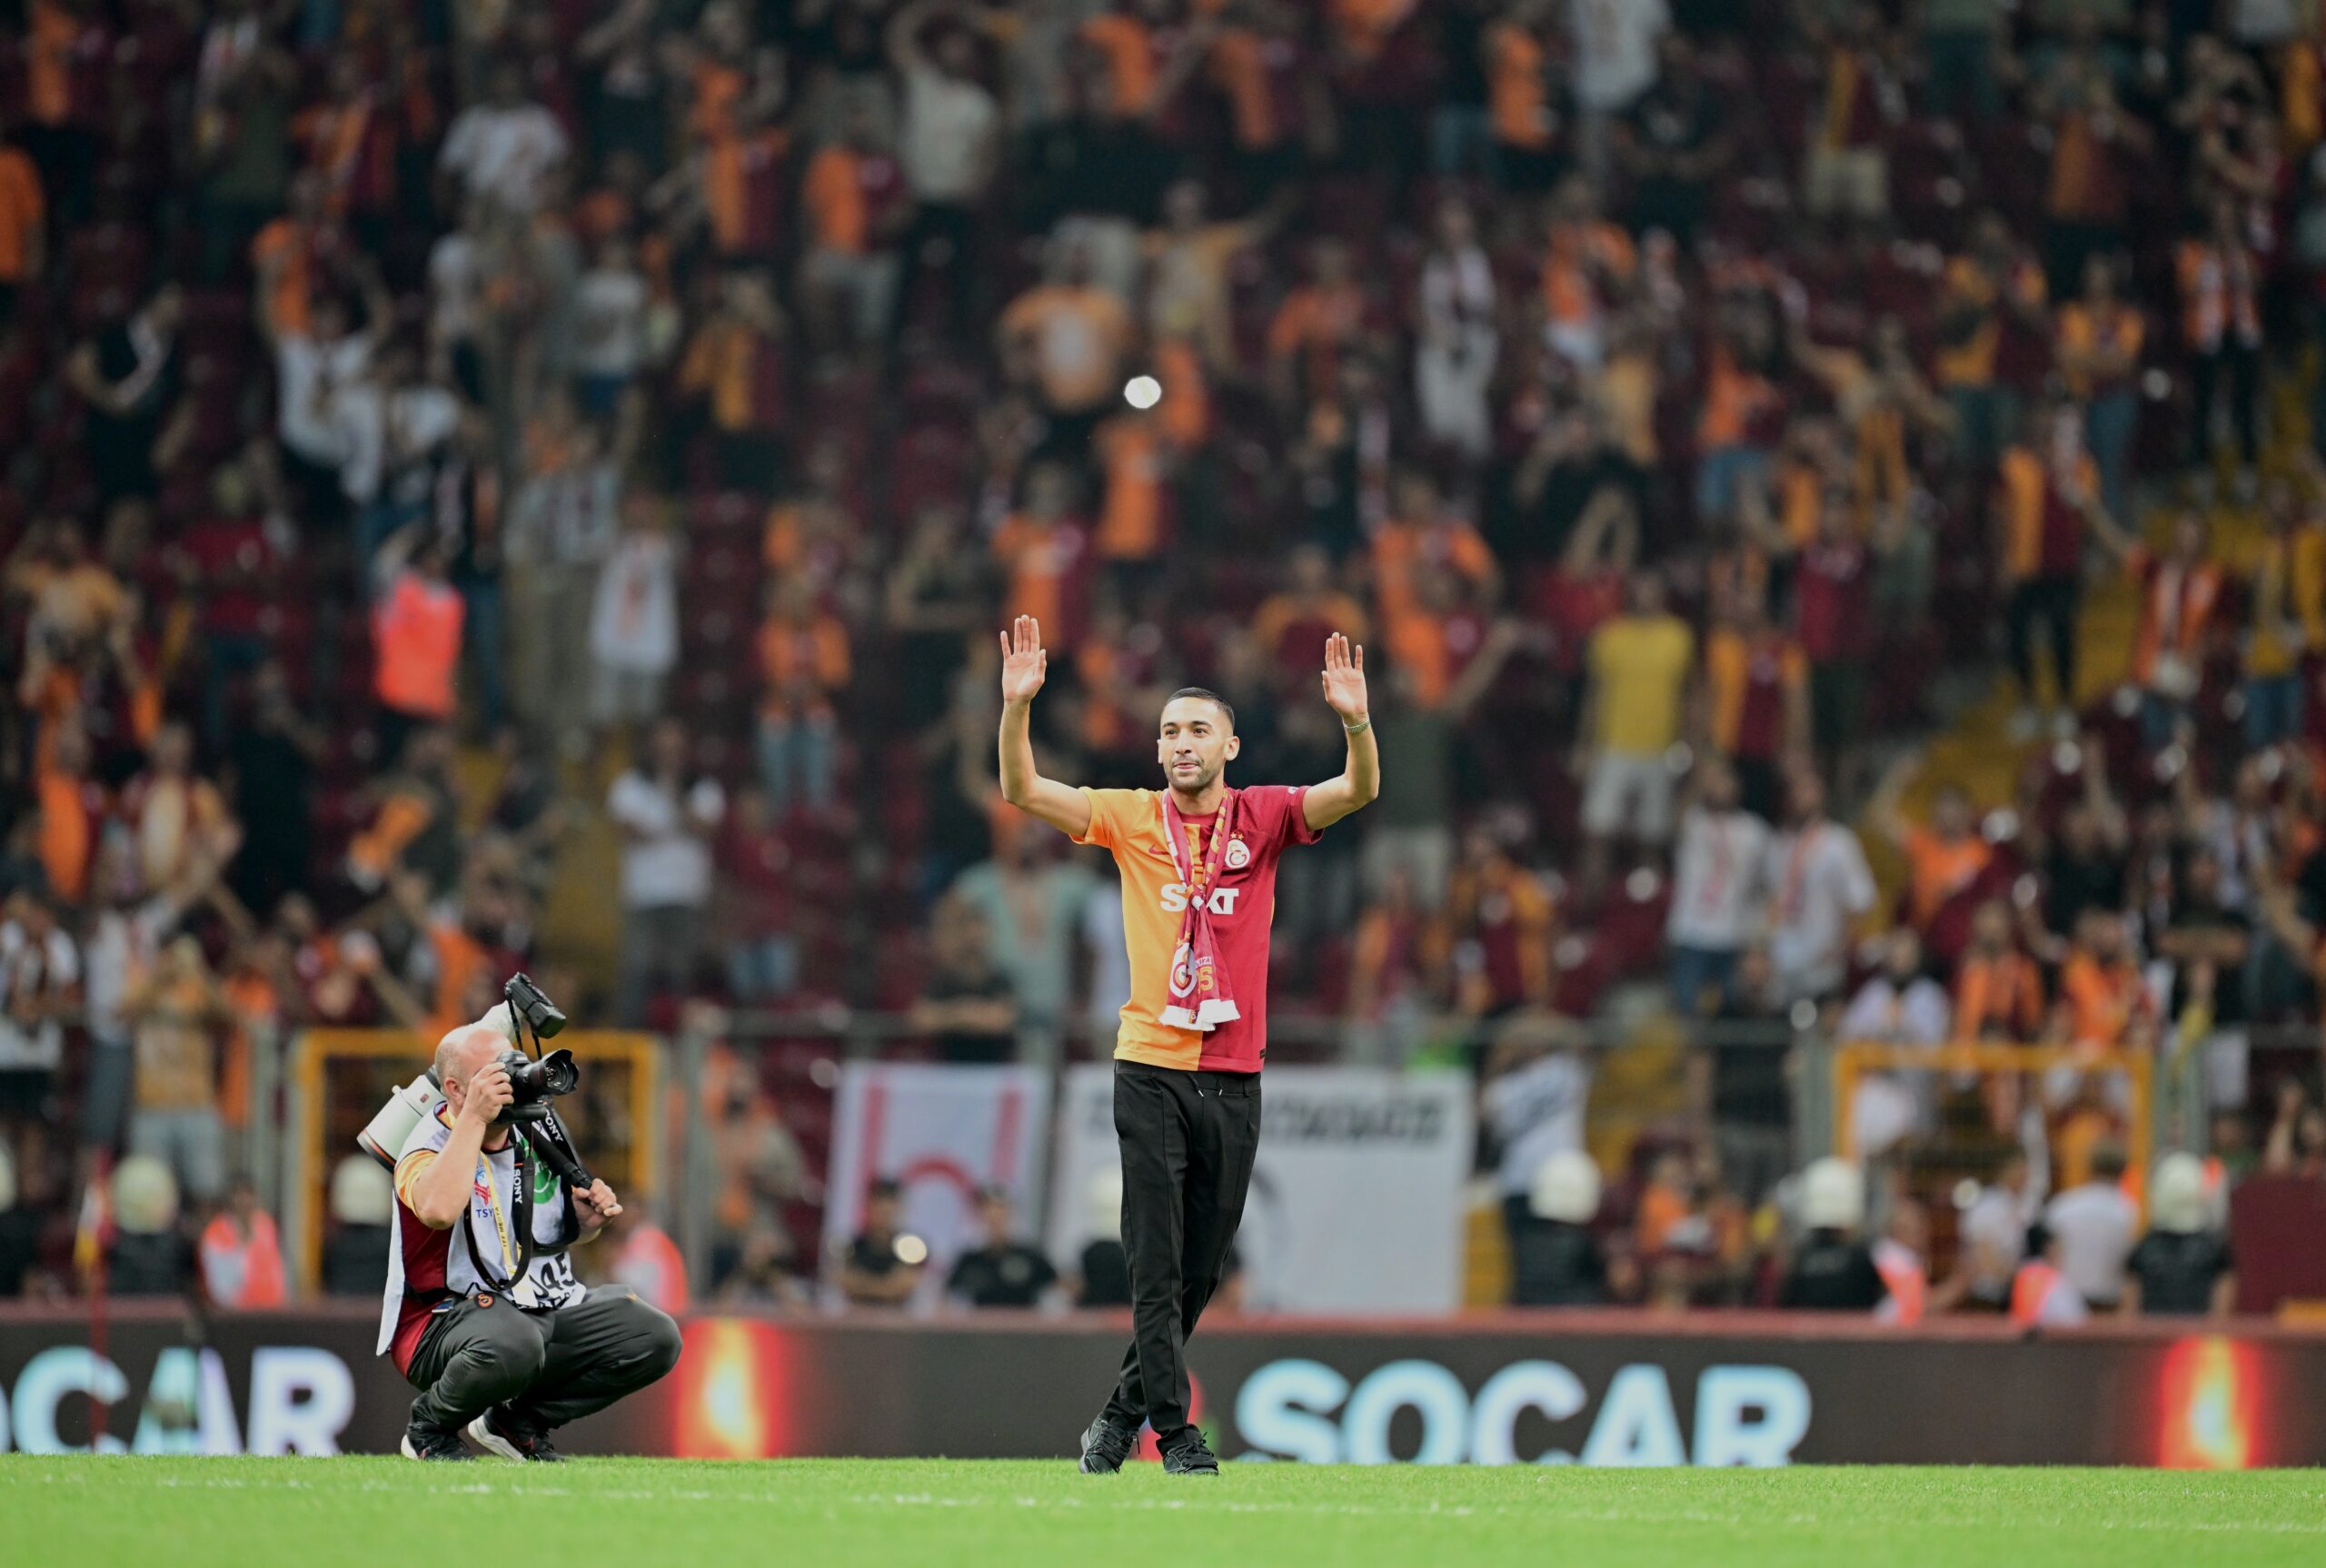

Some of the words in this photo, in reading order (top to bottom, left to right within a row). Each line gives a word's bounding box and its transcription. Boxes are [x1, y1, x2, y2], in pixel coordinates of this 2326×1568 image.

[1159, 883, 1239, 915] SXT
[513, 1168, 523, 1205] SONY
[475, 1208, 494, 1218] TSY
[0, 1345, 355, 1455] CAR
[1235, 1358, 1813, 1465] SOCAR
